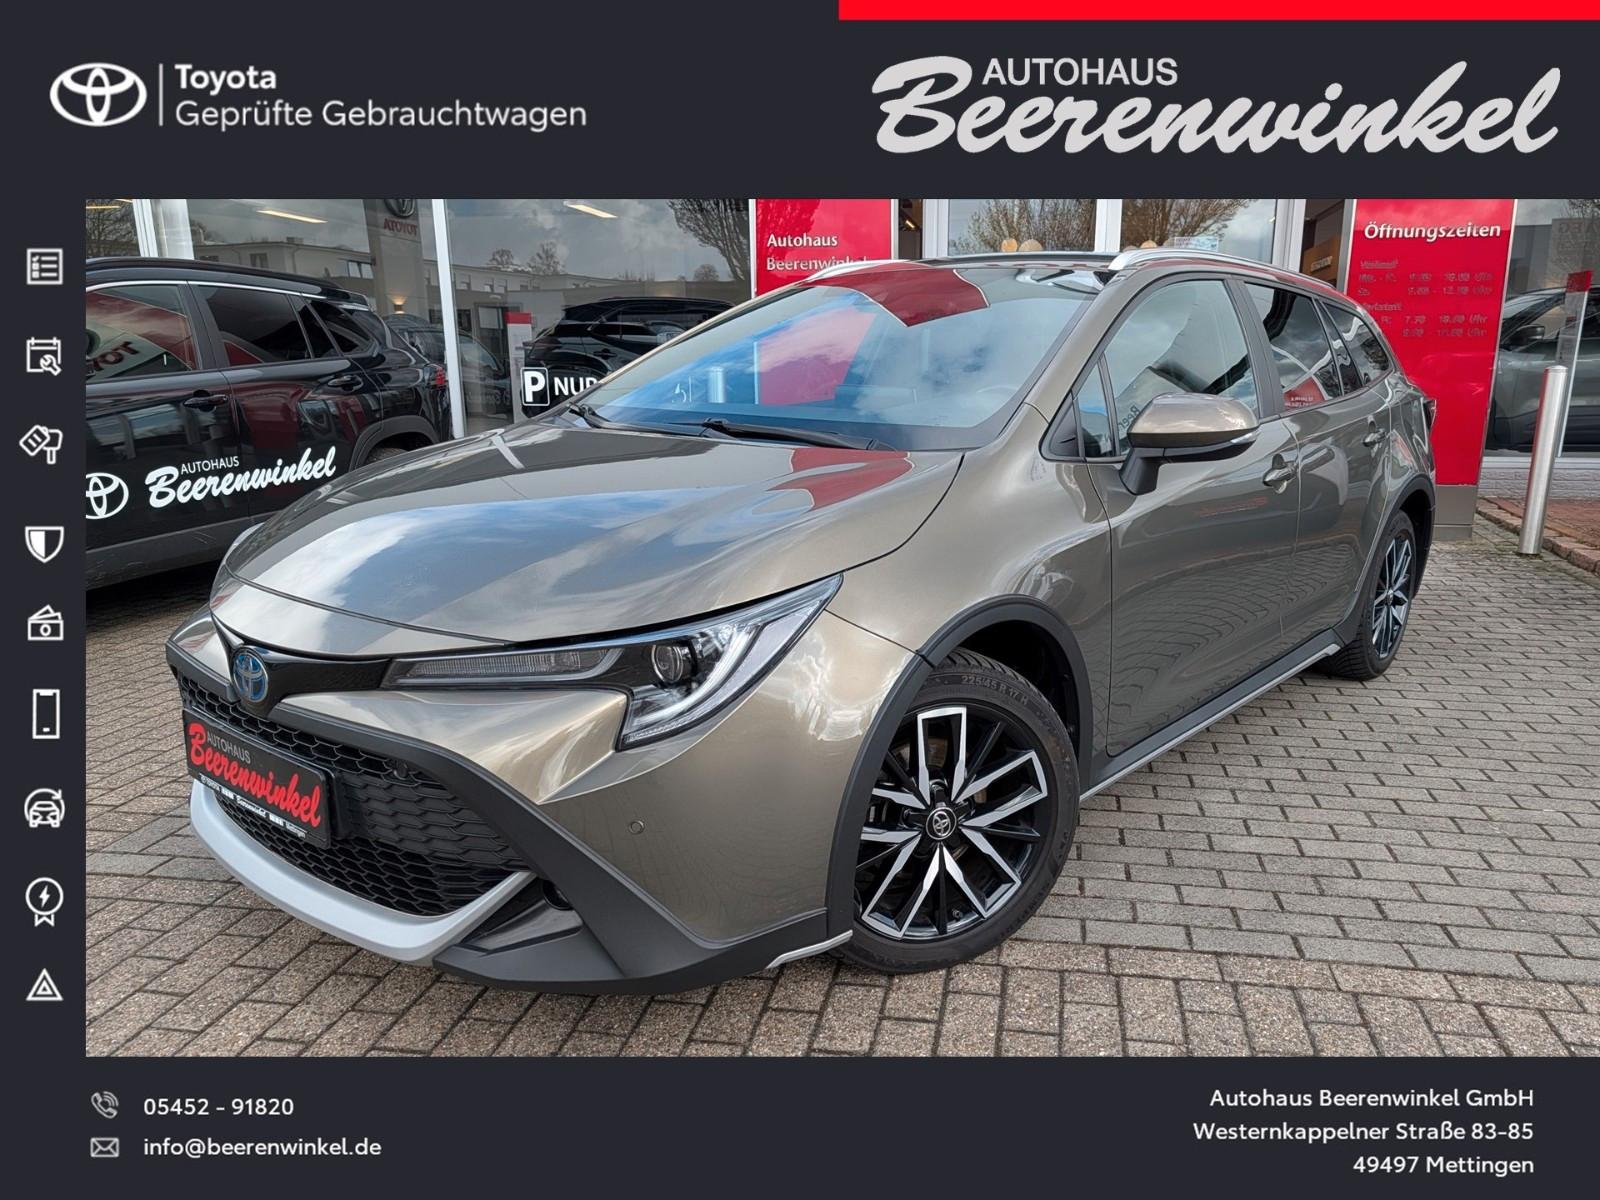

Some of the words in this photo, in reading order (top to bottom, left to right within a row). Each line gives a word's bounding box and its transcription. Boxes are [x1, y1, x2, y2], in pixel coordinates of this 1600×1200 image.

[767, 233, 838, 247] Autohaus
[1364, 221, 1501, 242] Öffnungszeiten
[524, 371, 546, 402] P
[144, 446, 336, 508] Beerenwinkel
[181, 456, 240, 475] AUTOHAUS
[206, 731, 251, 764] AUTOHAUS
[188, 723, 321, 827] Beerenwinkel
